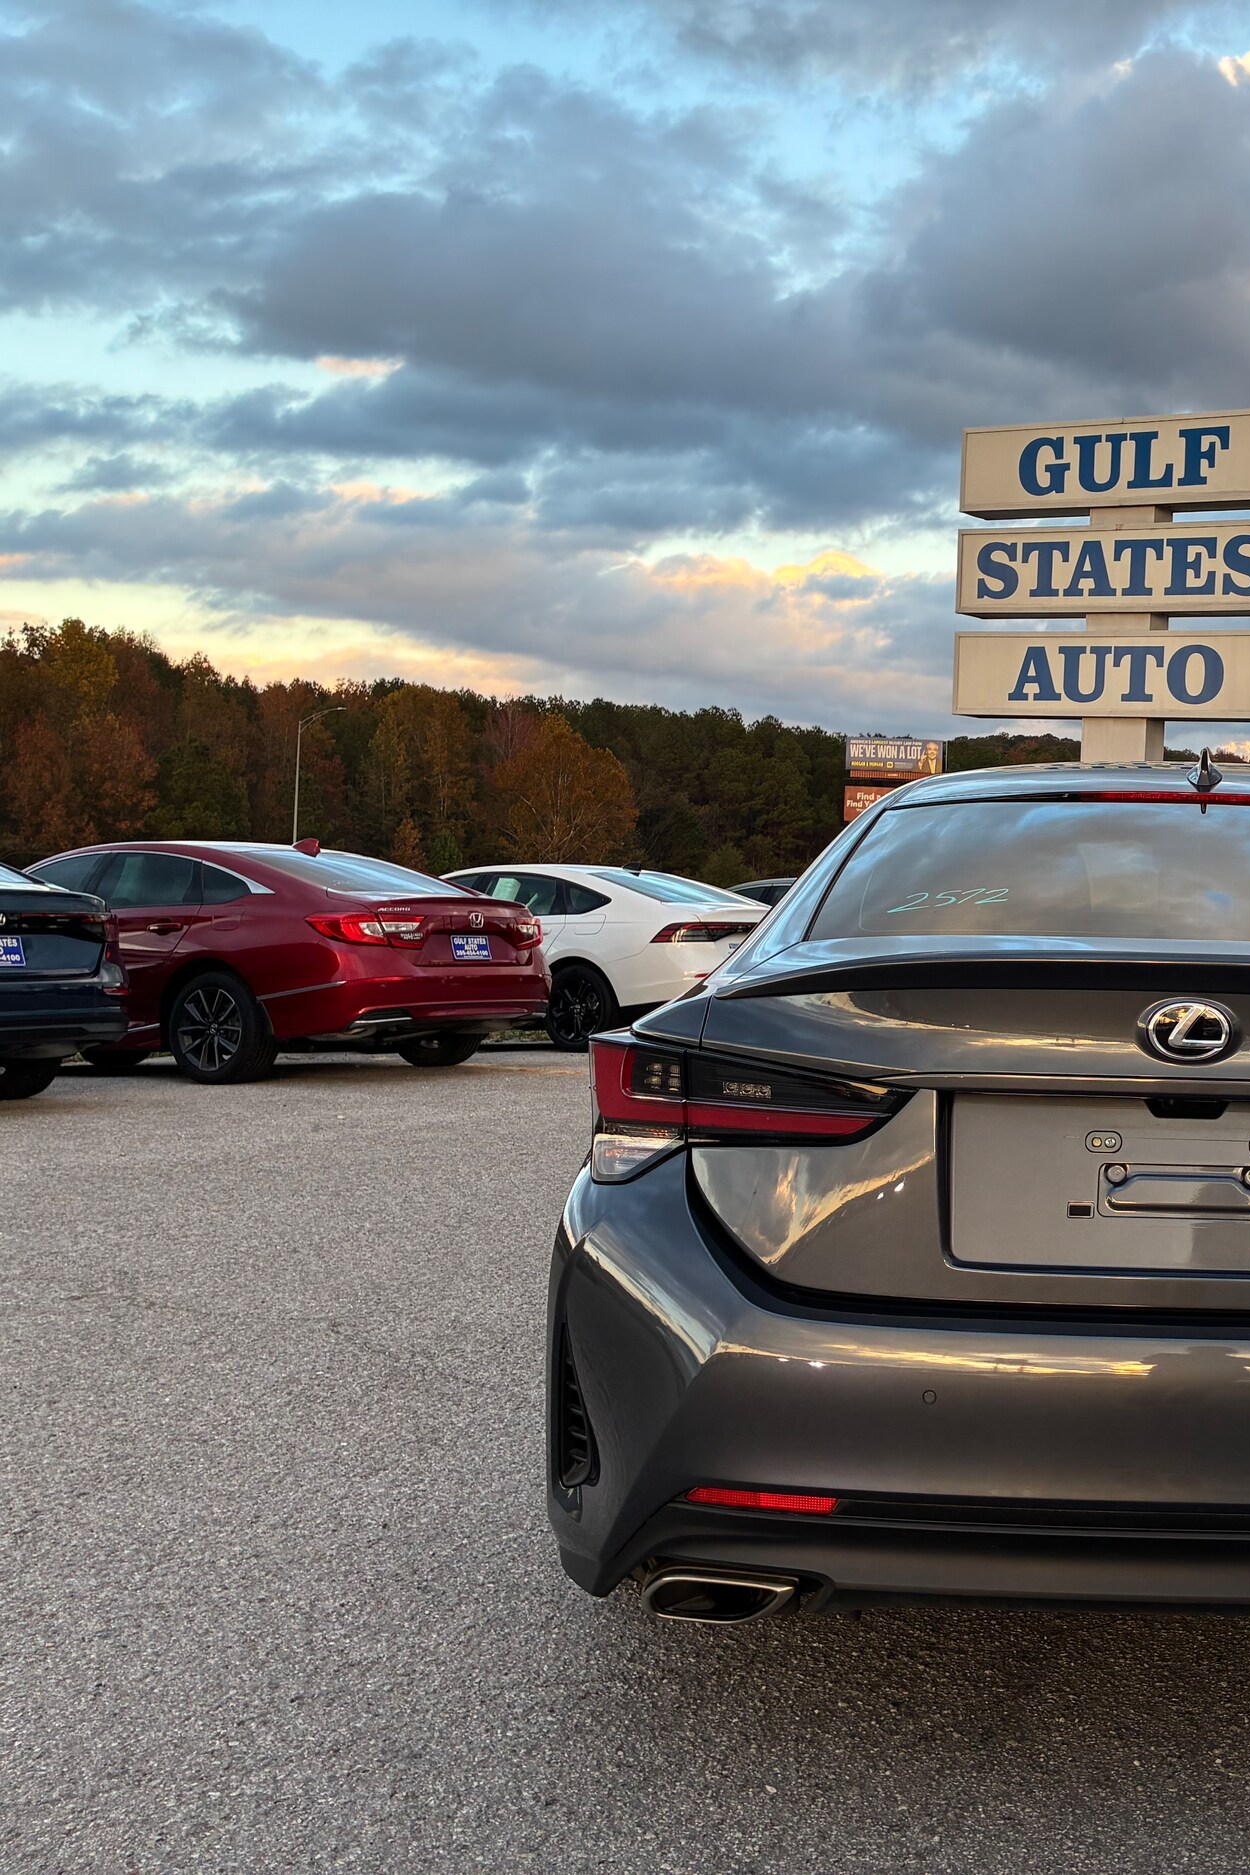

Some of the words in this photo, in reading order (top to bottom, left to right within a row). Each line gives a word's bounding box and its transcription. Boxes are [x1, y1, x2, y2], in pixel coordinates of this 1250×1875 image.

[1019, 426, 1230, 496] GULF
[1008, 644, 1224, 705] AUTO
[850, 744, 876, 758] WE'VE
[877, 745, 897, 759] WON
[899, 745, 905, 759] A
[907, 746, 922, 760] LOT
[846, 800, 863, 808] Find
[857, 792, 875, 800] Find
